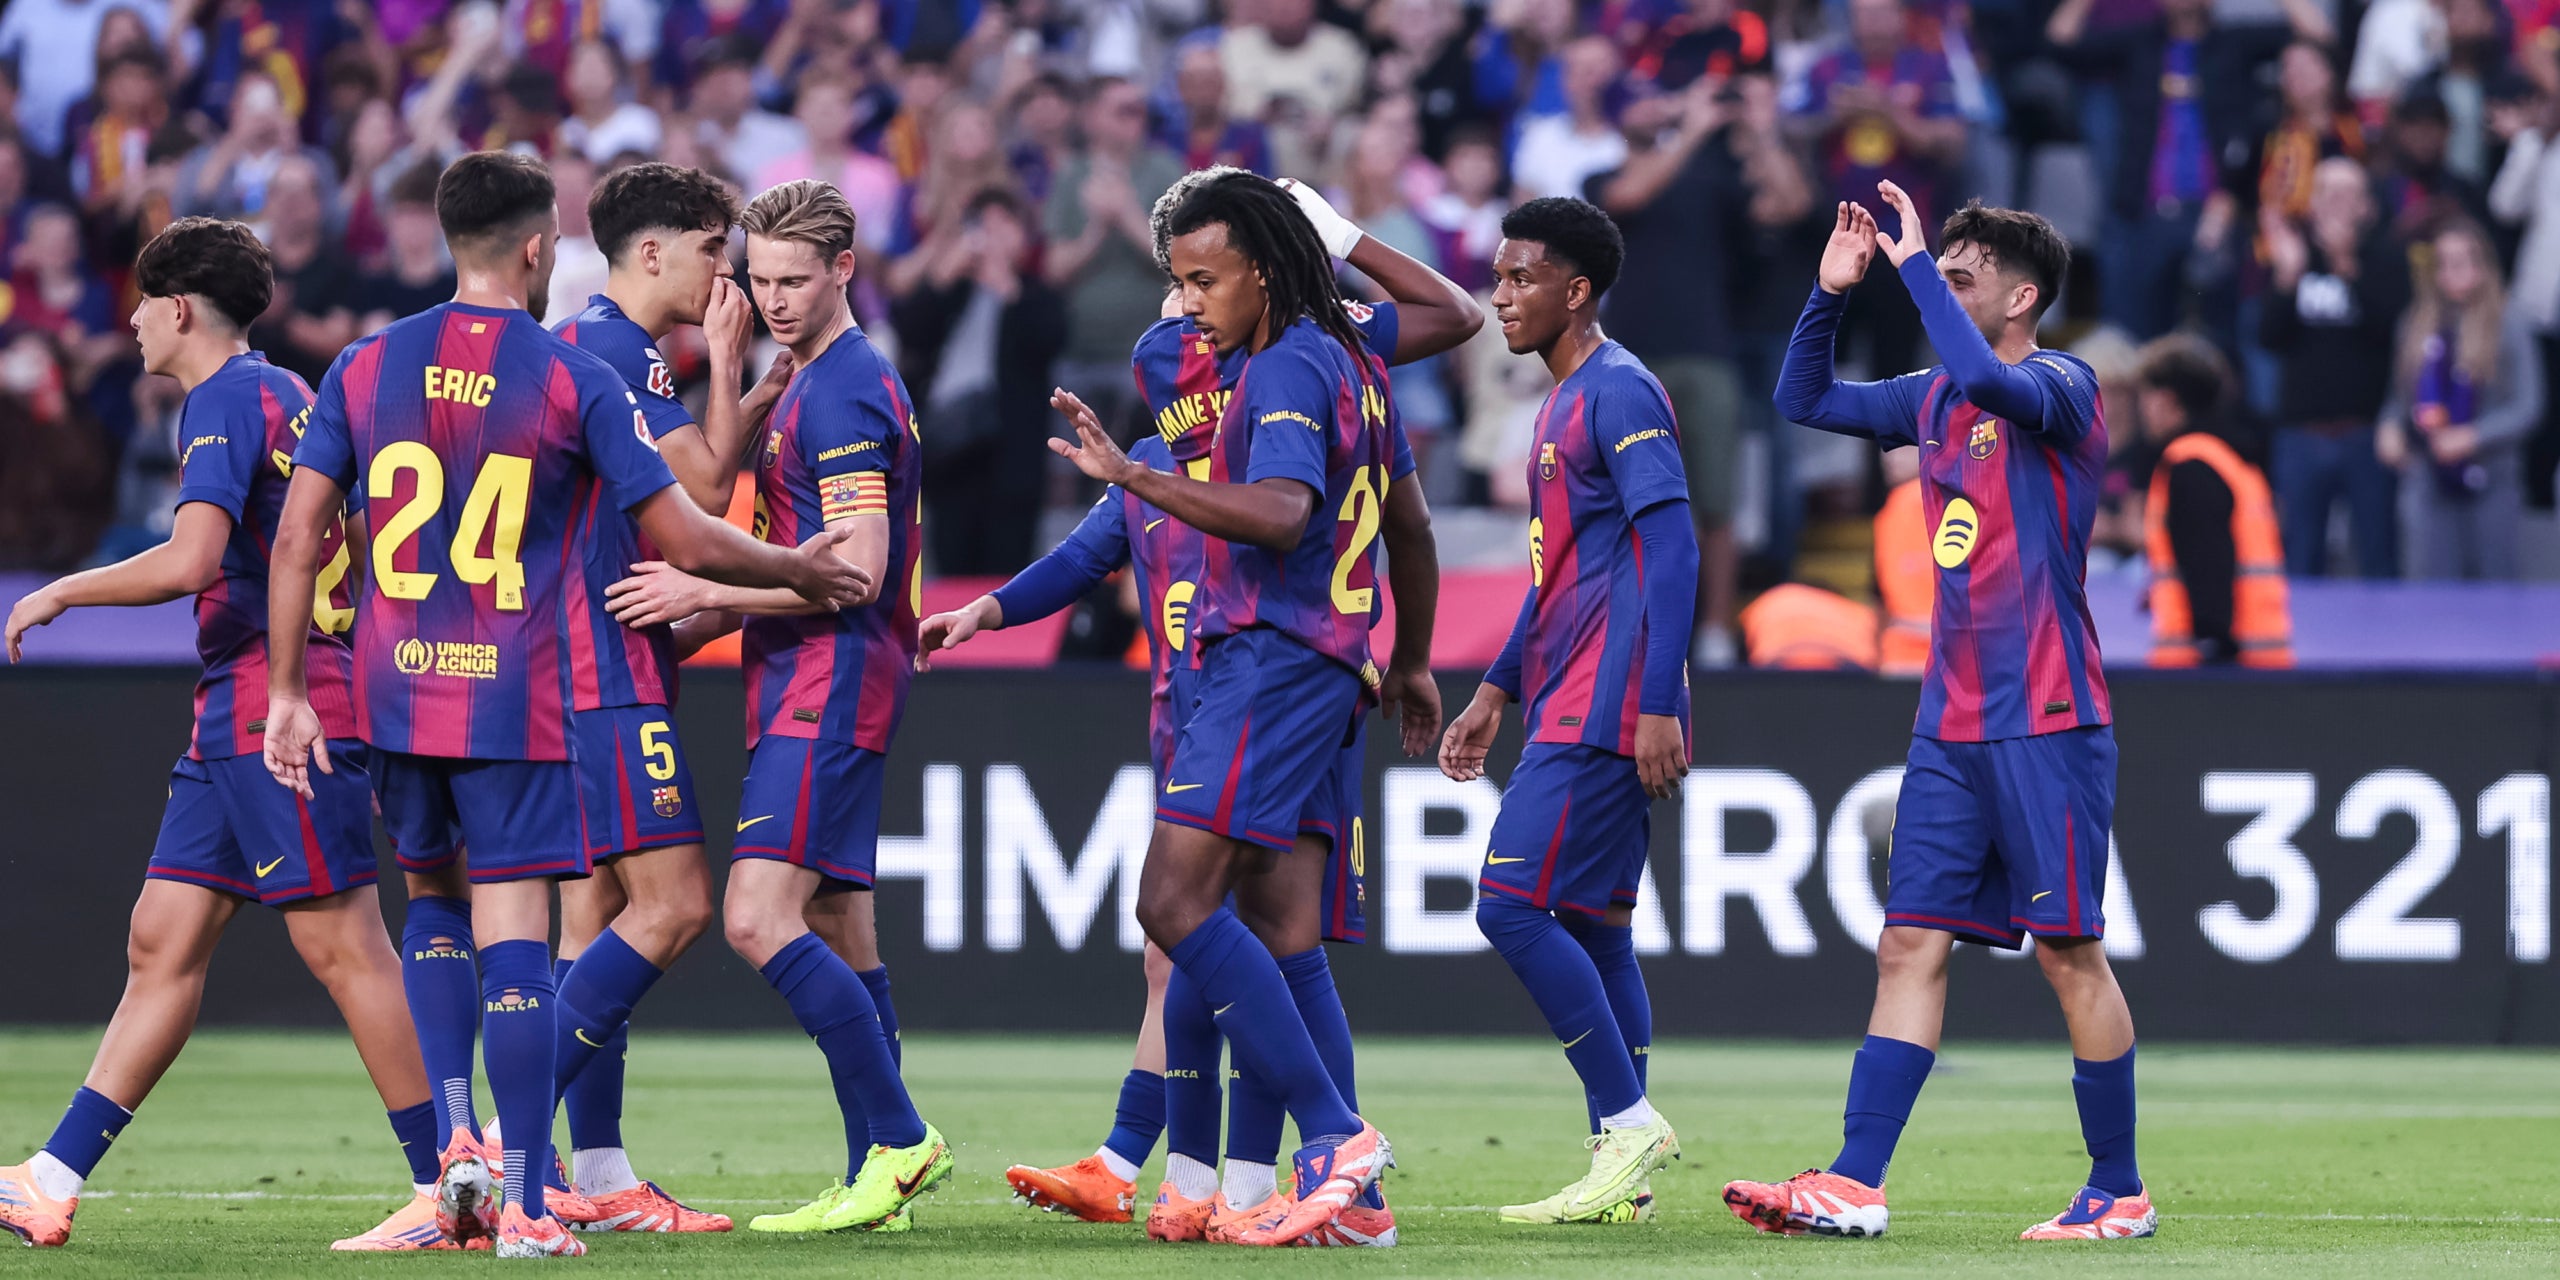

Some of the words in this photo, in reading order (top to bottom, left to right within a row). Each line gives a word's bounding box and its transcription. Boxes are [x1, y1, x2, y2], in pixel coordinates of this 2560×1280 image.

[425, 365, 496, 408] ERIC
[1260, 410, 1312, 426] AMBILIGHT
[818, 440, 870, 462] AMBILIGHT
[368, 440, 533, 611] 24
[435, 655, 497, 673] ACNUR
[436, 641, 498, 659] UNHCR
[640, 720, 676, 781] 5
[2197, 768, 2551, 962] 321
